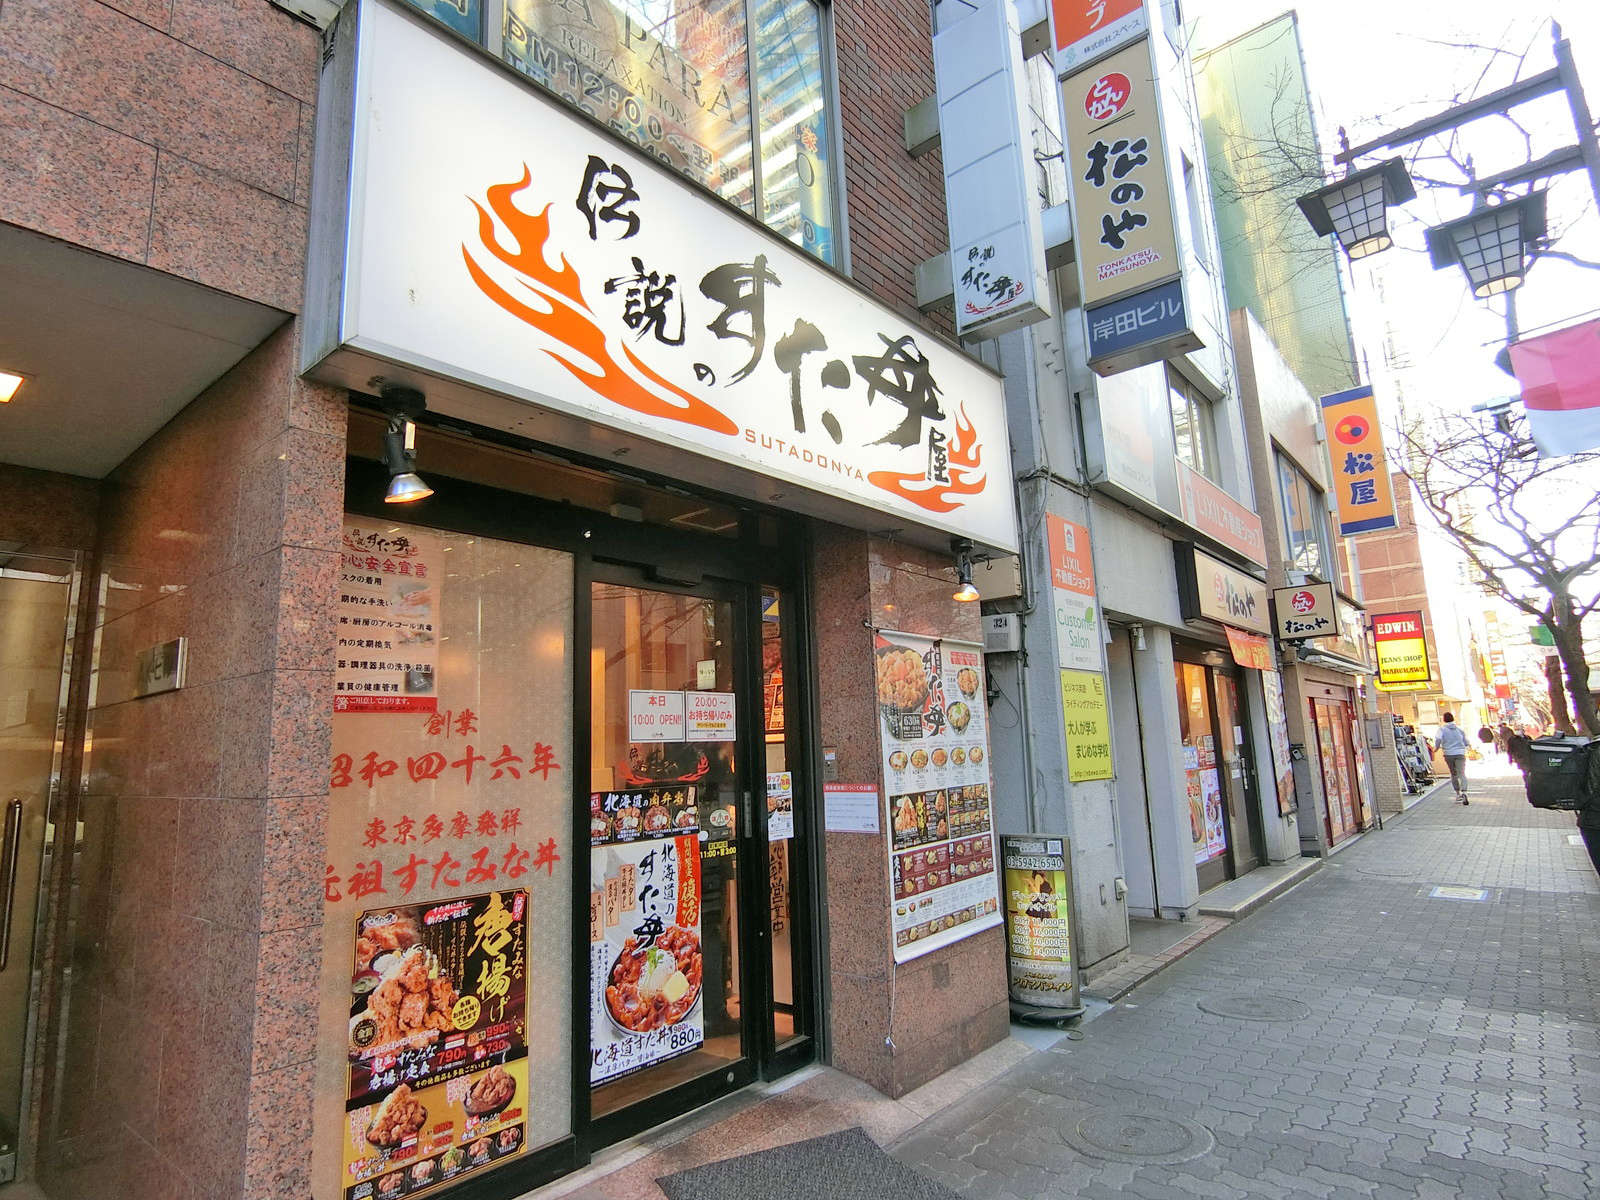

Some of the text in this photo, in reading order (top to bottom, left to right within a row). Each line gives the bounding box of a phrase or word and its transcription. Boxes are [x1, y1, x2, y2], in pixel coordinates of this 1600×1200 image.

[1086, 0, 1107, 29] プ
[561, 27, 688, 127] RELAXATION
[1085, 138, 1148, 250] 松のや
[1099, 249, 1152, 273] TONKATSU
[1099, 255, 1160, 280] MATSUNOYA
[1093, 298, 1182, 343] 岸田ビル
[744, 428, 864, 483] SUTADONYA
[1343, 452, 1378, 505] 松屋
[1061, 554, 1082, 573] LIXIL
[1055, 568, 1091, 590] 不動産ショップ
[993, 617, 1008, 628] 324
[1057, 608, 1096, 632] Customer
[1285, 617, 1329, 633] 松のや
[1069, 630, 1090, 648] Salon
[1381, 654, 1423, 665] JEANS SHOP
[1382, 667, 1426, 675] MARUKAWA
[649, 695, 666, 706] 本日
[423, 708, 478, 739] 創業
[633, 714, 655, 725] 10:00
[689, 710, 733, 720] お持ち帰りのみ
[1068, 720, 1097, 735] 大人が学ぶ
[1075, 744, 1109, 758] まじめな学校
[362, 808, 523, 848] 東京多摩発祥
[1007, 855, 1062, 869] 03-5942-6540
[661, 843, 676, 915] 北海道の
[1014, 916, 1029, 925] 60分
[1014, 926, 1067, 937] 90分 16,000円
[1012, 935, 1068, 947] 120分 20,000円
[512, 923, 525, 980] すたみな
[1034, 947, 1069, 957] 24,000円
[456, 1012, 477, 1023] できます
